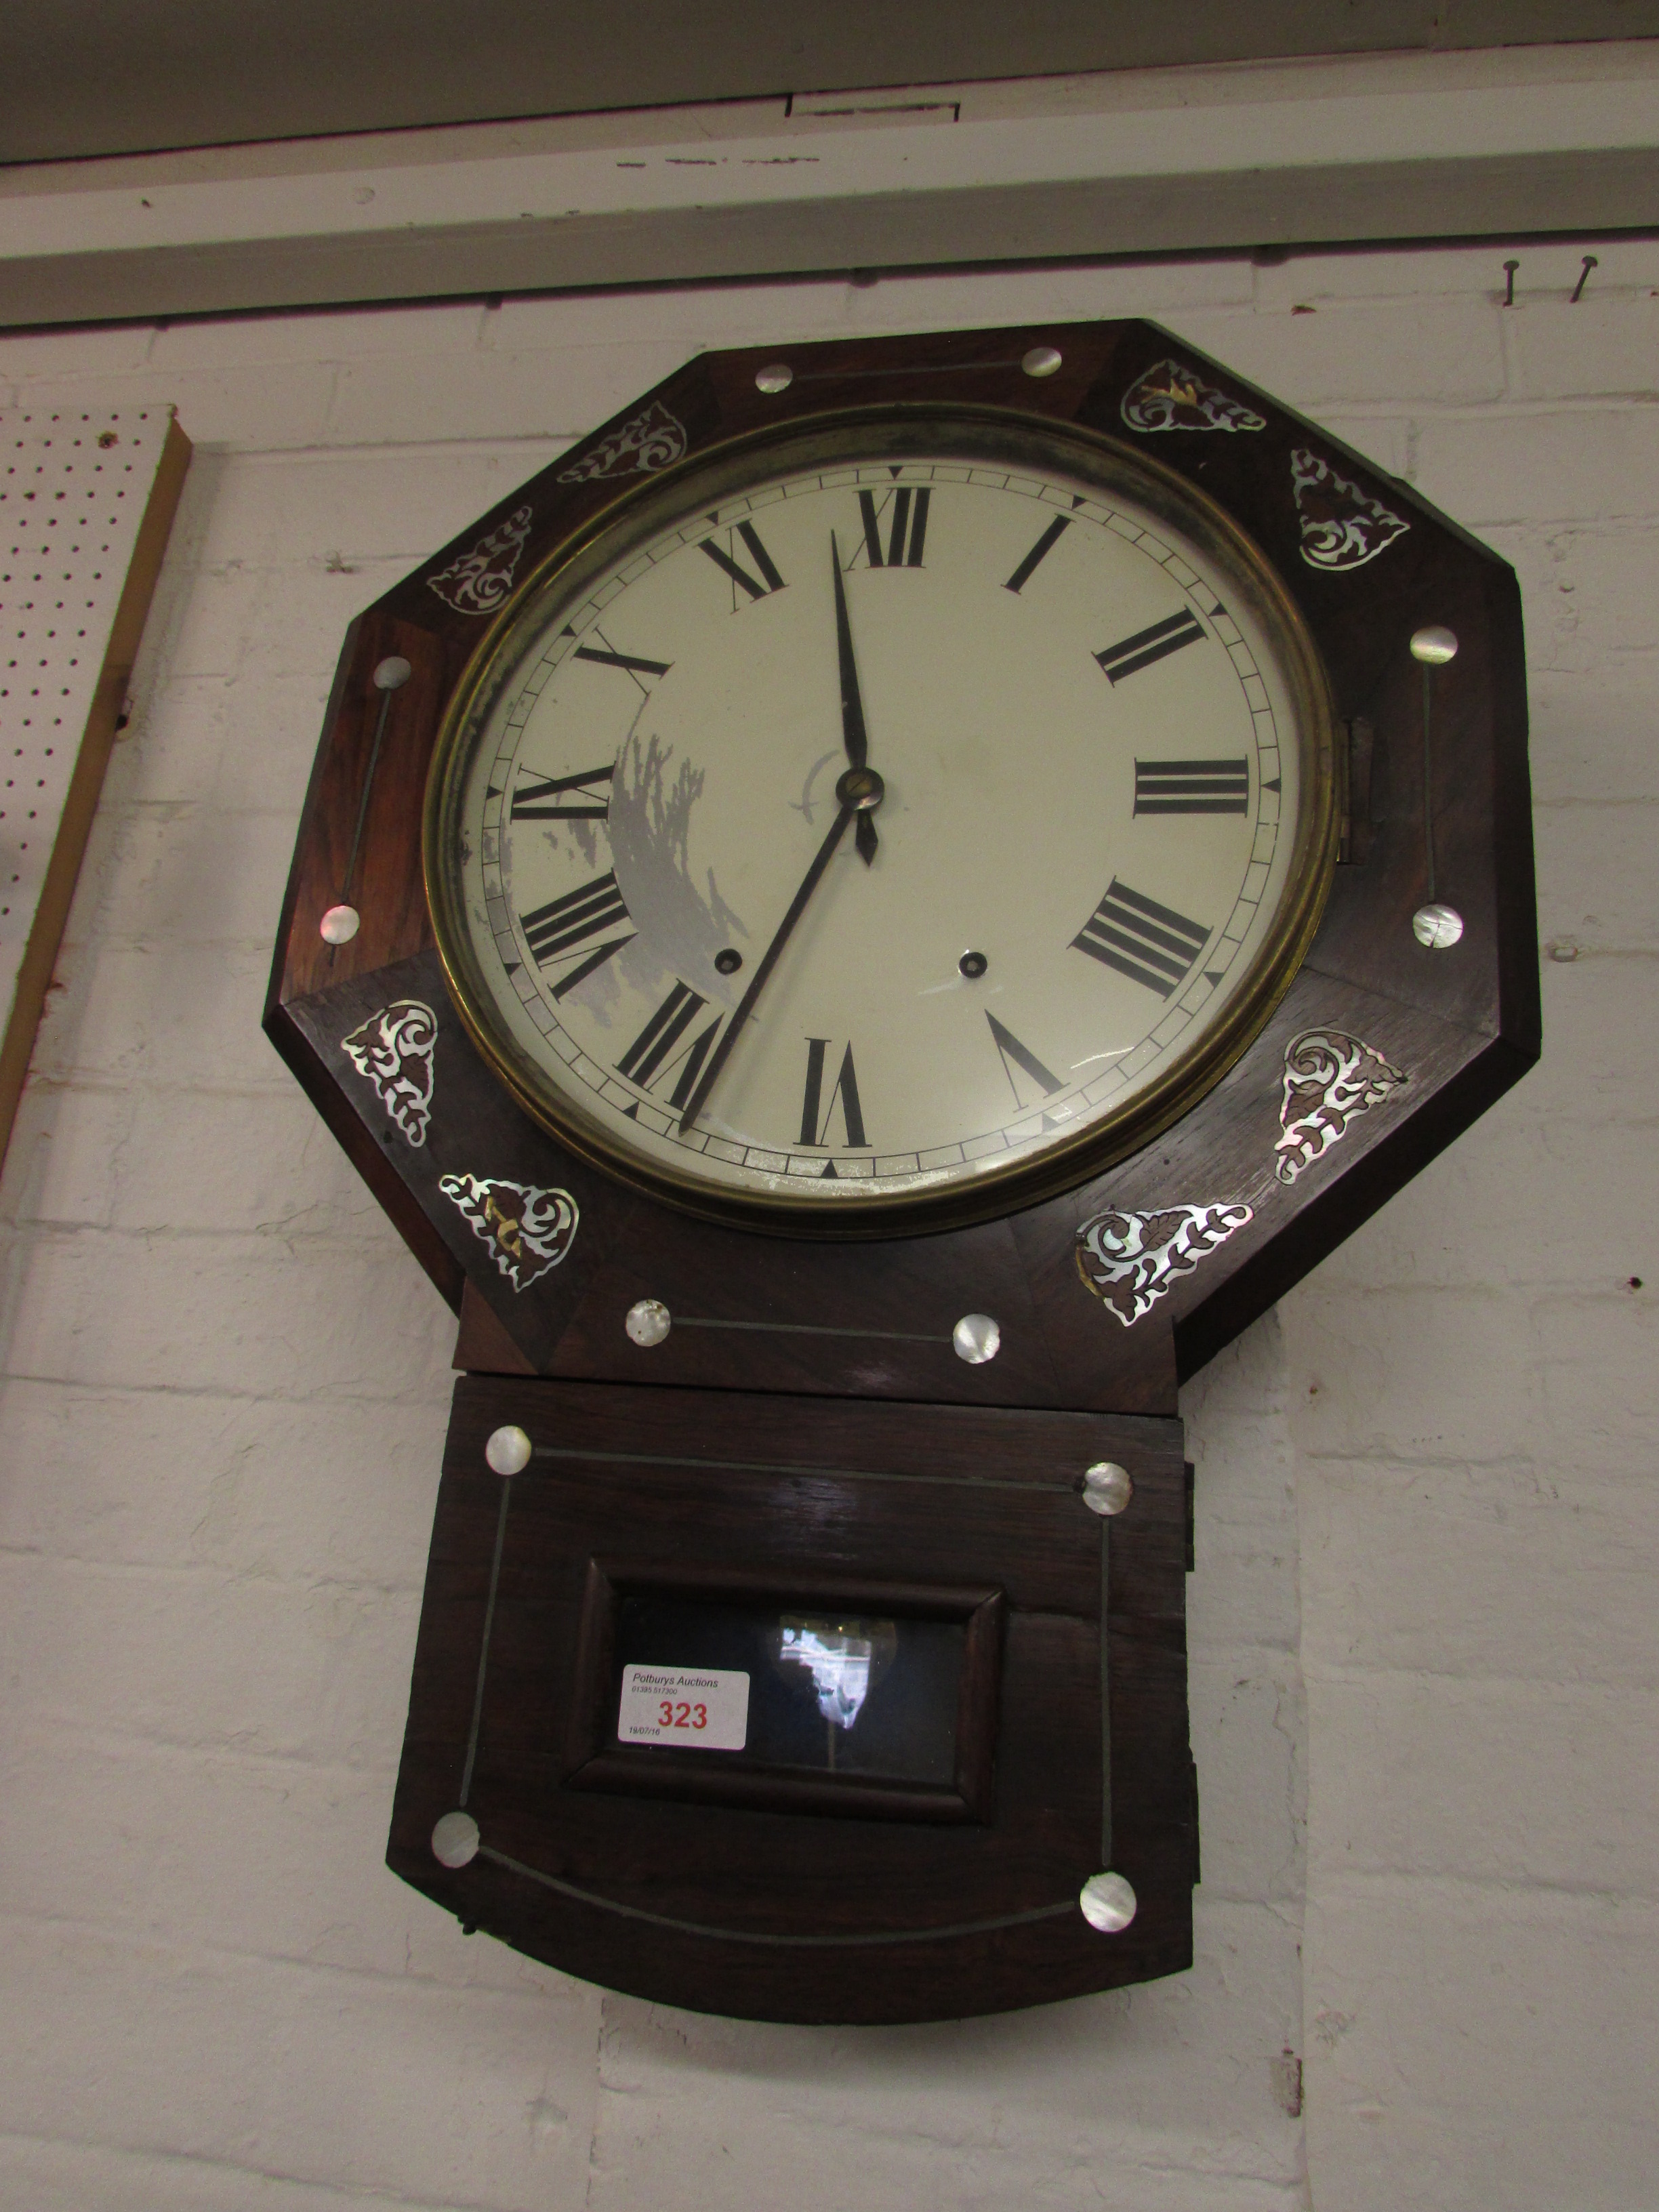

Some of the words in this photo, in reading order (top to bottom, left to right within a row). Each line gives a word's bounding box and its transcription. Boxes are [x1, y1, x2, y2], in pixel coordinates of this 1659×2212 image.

[697, 518, 790, 614] XI
[843, 487, 936, 571] XII
[1000, 513, 1076, 594] I
[571, 624, 676, 697] X
[1092, 605, 1208, 687] II
[510, 760, 617, 824] IX
[1132, 754, 1248, 819] III
[519, 867, 639, 1004] VIII
[1067, 876, 1214, 1002] IIII
[612, 978, 724, 1111] VII
[985, 1009, 1071, 1112] V
[793, 1038, 872, 1147] VI
[632, 1673, 674, 1686] Potburys
[677, 1676, 718, 1688] Auctions
[658, 1701, 708, 1729] 323
